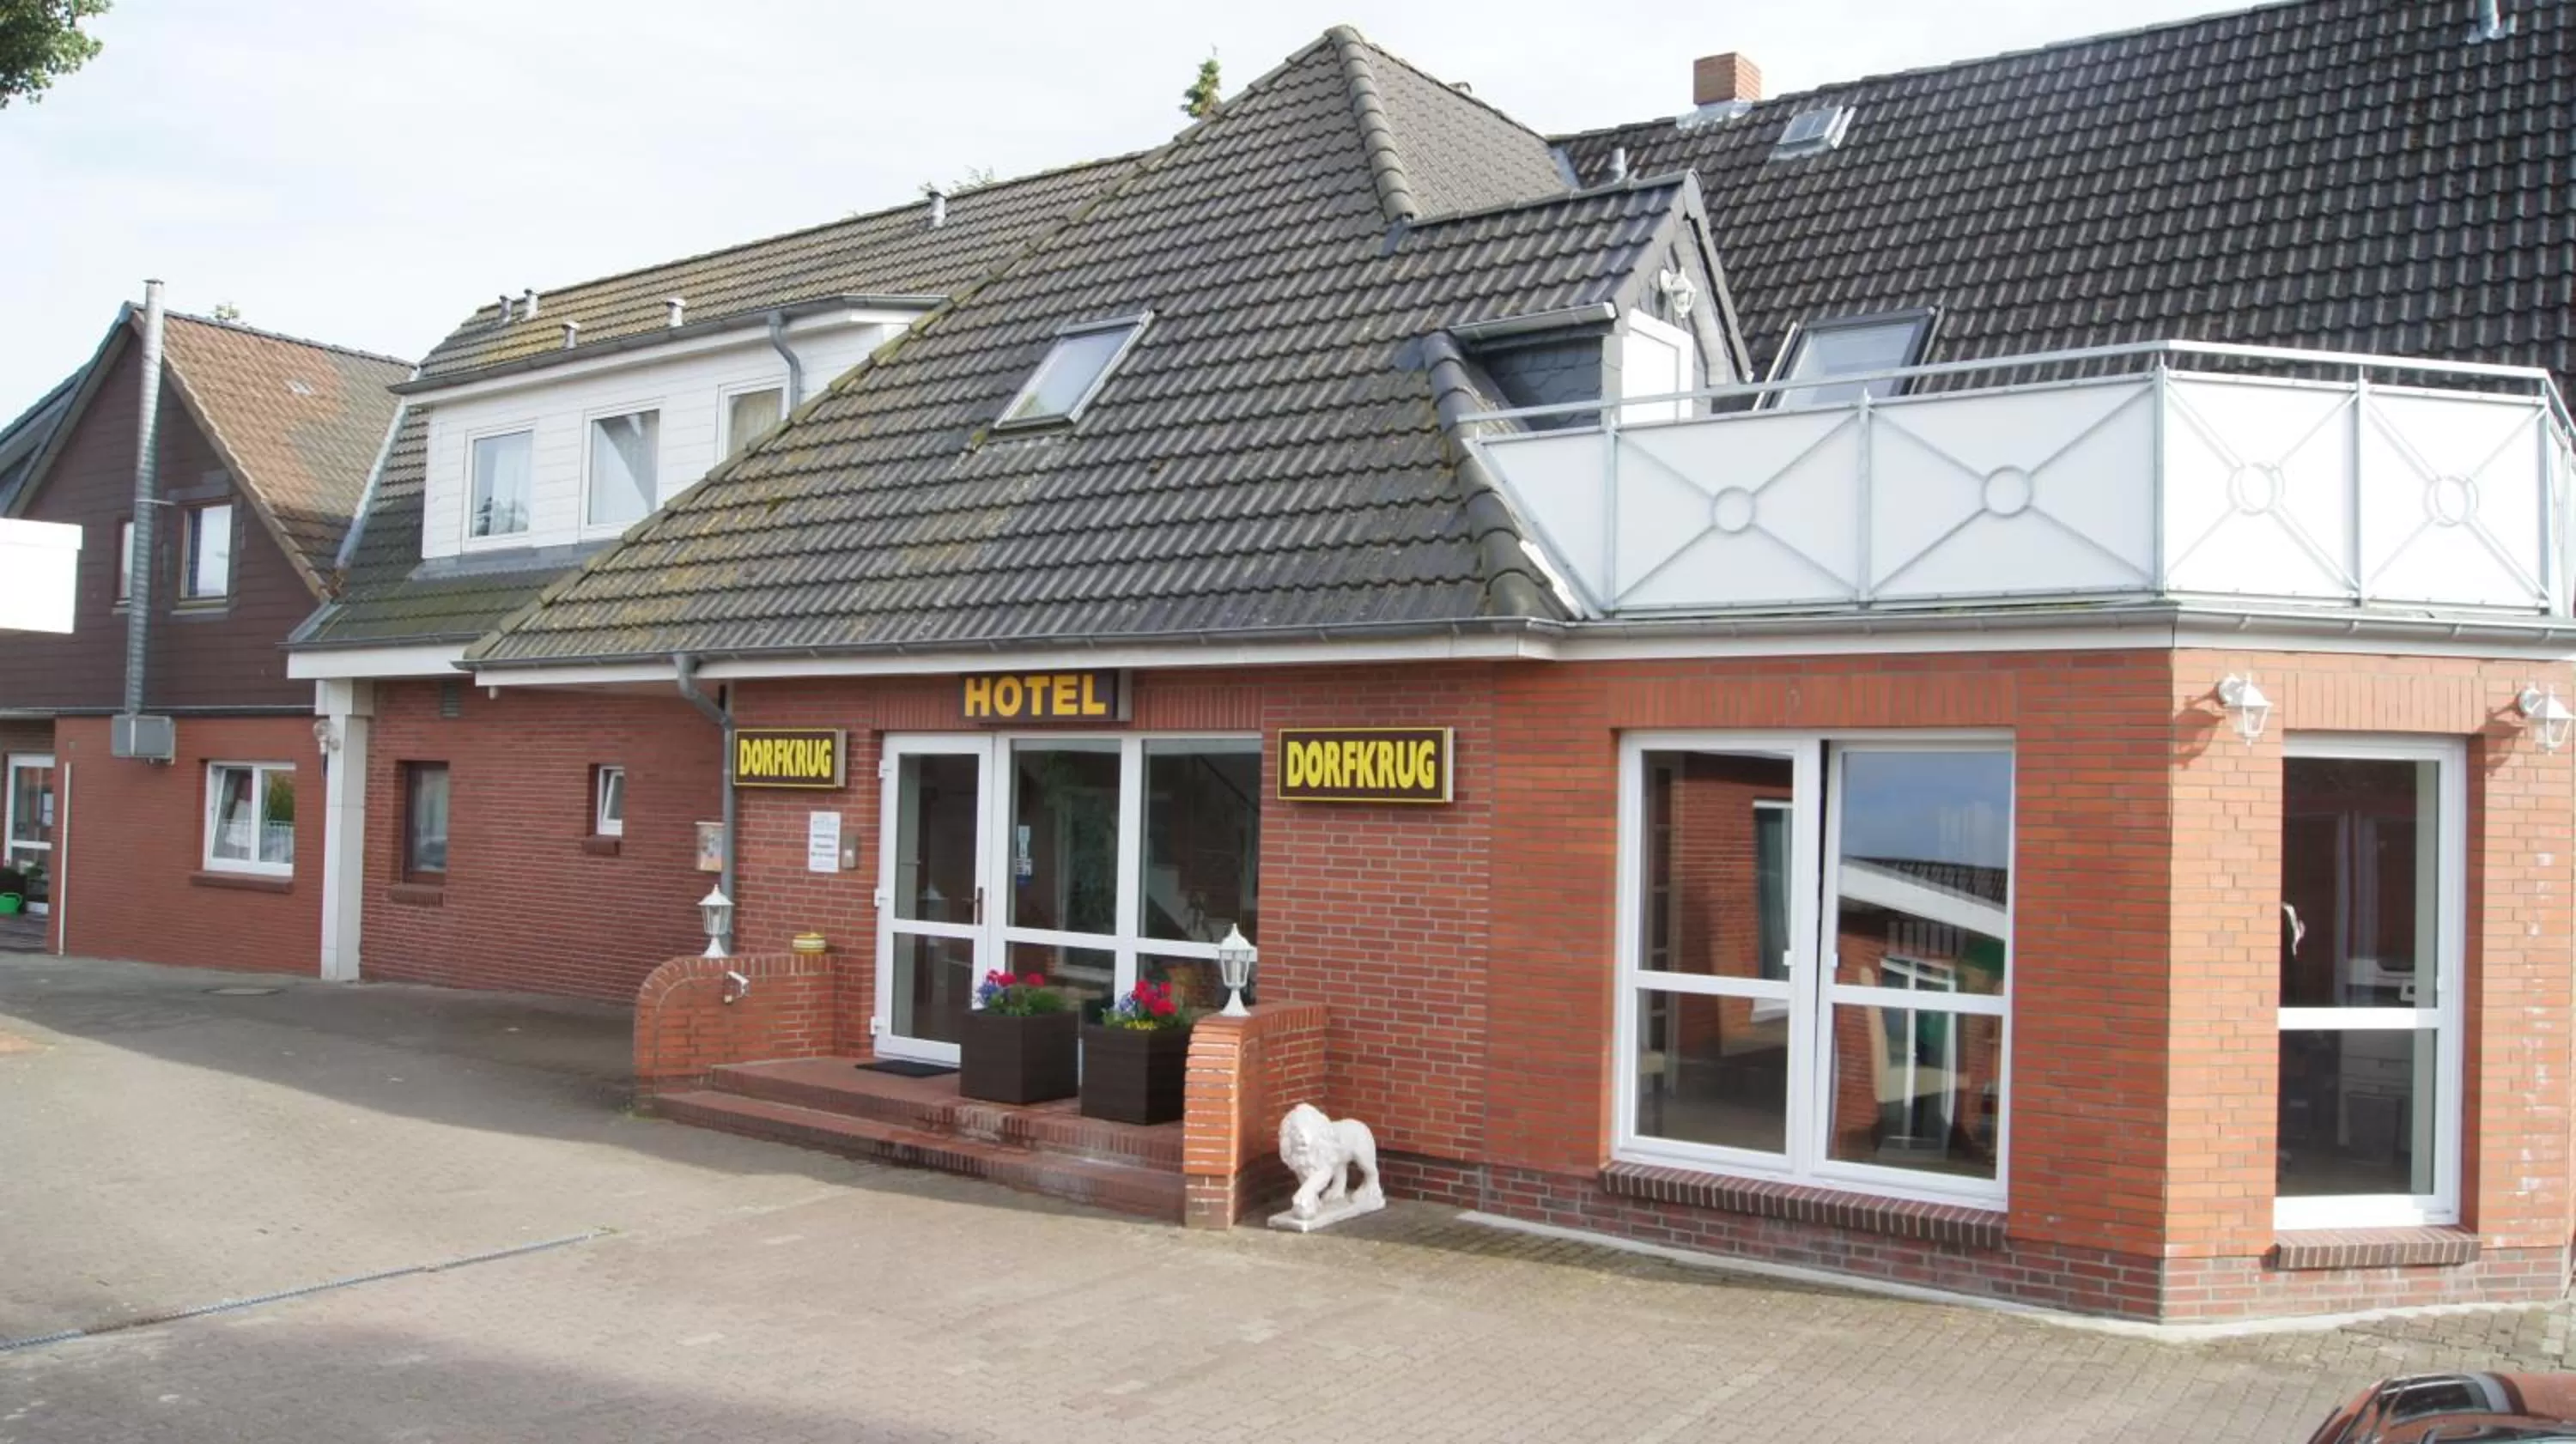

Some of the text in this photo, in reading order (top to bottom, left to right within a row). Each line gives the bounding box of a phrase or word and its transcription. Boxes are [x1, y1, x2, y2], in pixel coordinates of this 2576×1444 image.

[965, 675, 1106, 716] HOTEL
[739, 739, 832, 777] DORFKRUG
[1287, 740, 1436, 789] DORFKRUG
